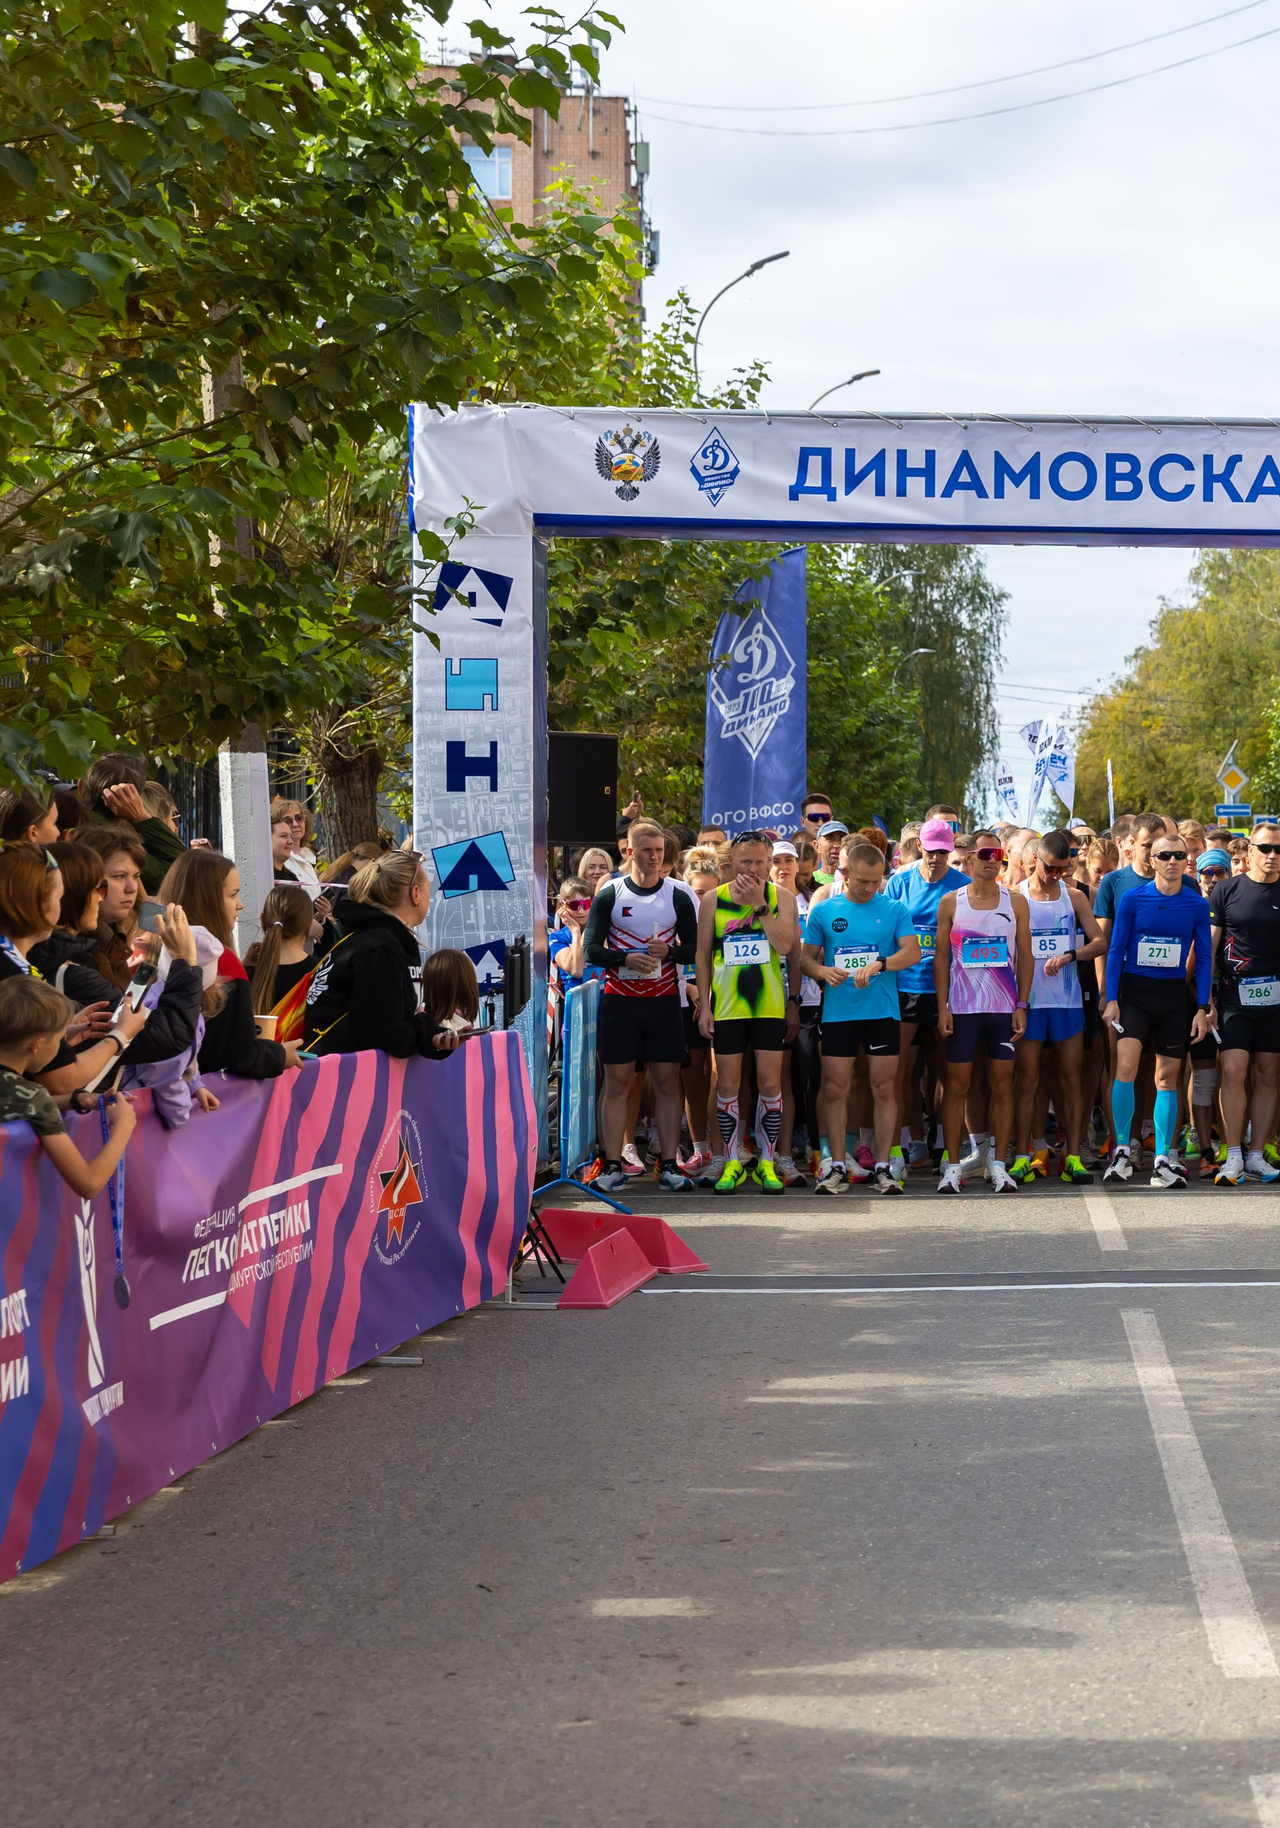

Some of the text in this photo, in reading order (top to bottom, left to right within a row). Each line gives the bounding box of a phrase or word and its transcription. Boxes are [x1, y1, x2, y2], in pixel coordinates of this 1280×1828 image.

[723, 699, 788, 736] ДИНАМО
[711, 802, 795, 827] ОГО ВФСО
[733, 943, 760, 958] 126
[915, 934, 937, 947] 18
[970, 947, 999, 960] 495
[1038, 939, 1057, 952] 85
[241, 1200, 311, 1258] АТЛЕТИКИ
[227, 1254, 275, 1296] ДМУРТСКОЙ
[0, 1288, 31, 1339] ПОРТ
[0, 1355, 30, 1404] ИИ
